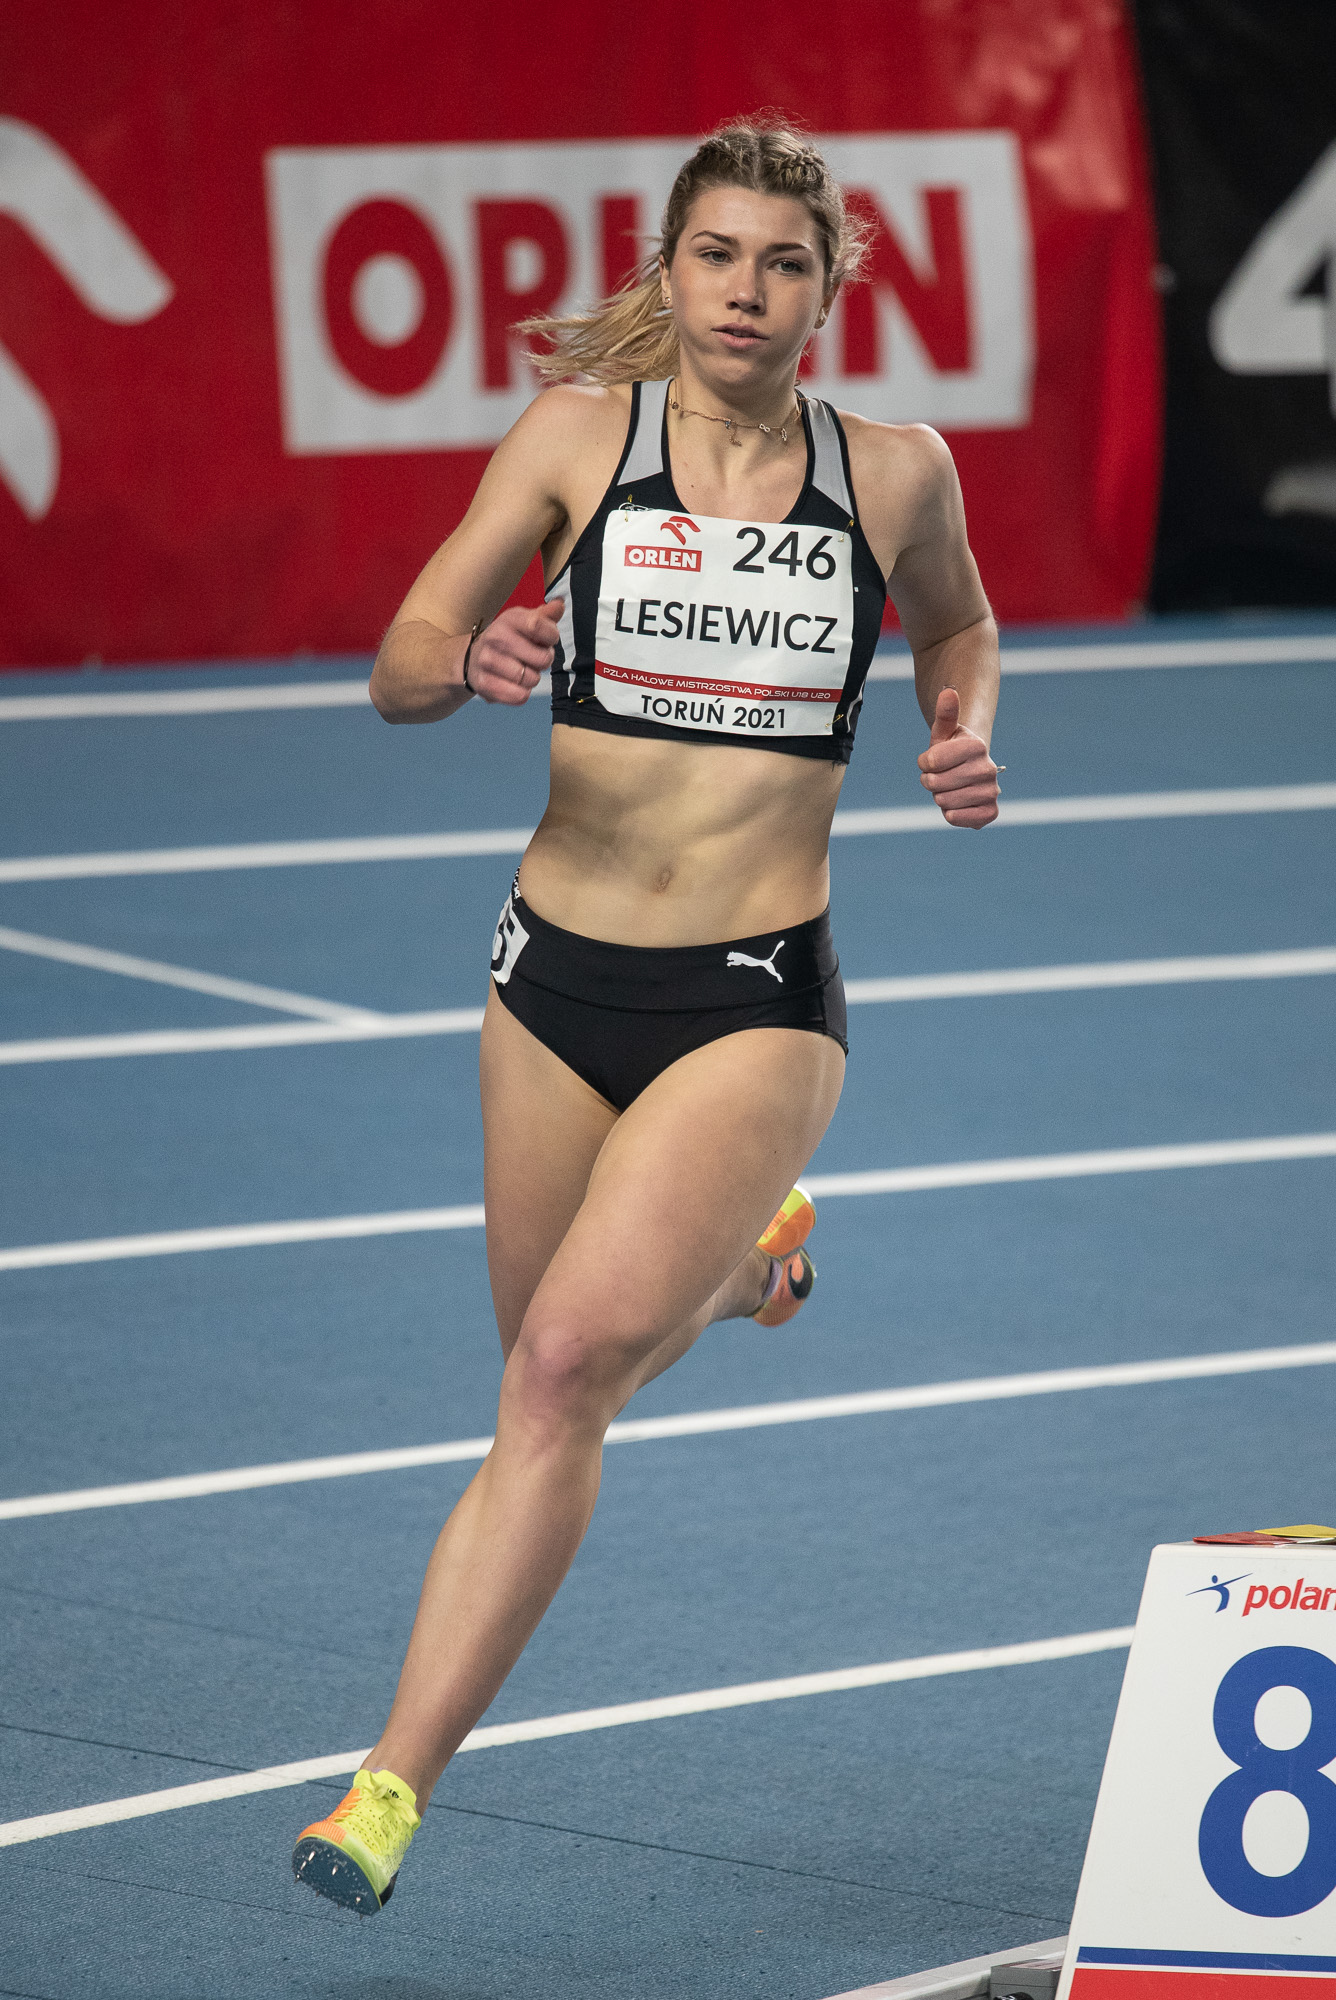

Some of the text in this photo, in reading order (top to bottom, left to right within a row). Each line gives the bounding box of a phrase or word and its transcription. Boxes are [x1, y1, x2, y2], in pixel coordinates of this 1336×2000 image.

[627, 548, 698, 569] ORLEN
[732, 526, 837, 581] 246
[614, 598, 838, 654] LESIEWICZ
[603, 667, 629, 680] PZLA
[631, 673, 674, 687] HALOWE
[676, 680, 752, 696] MISTRZOSTWA
[754, 688, 790, 698] POLSKI
[641, 694, 786, 730] TORUŃ 2021
[1198, 1645, 1336, 1918] 8
